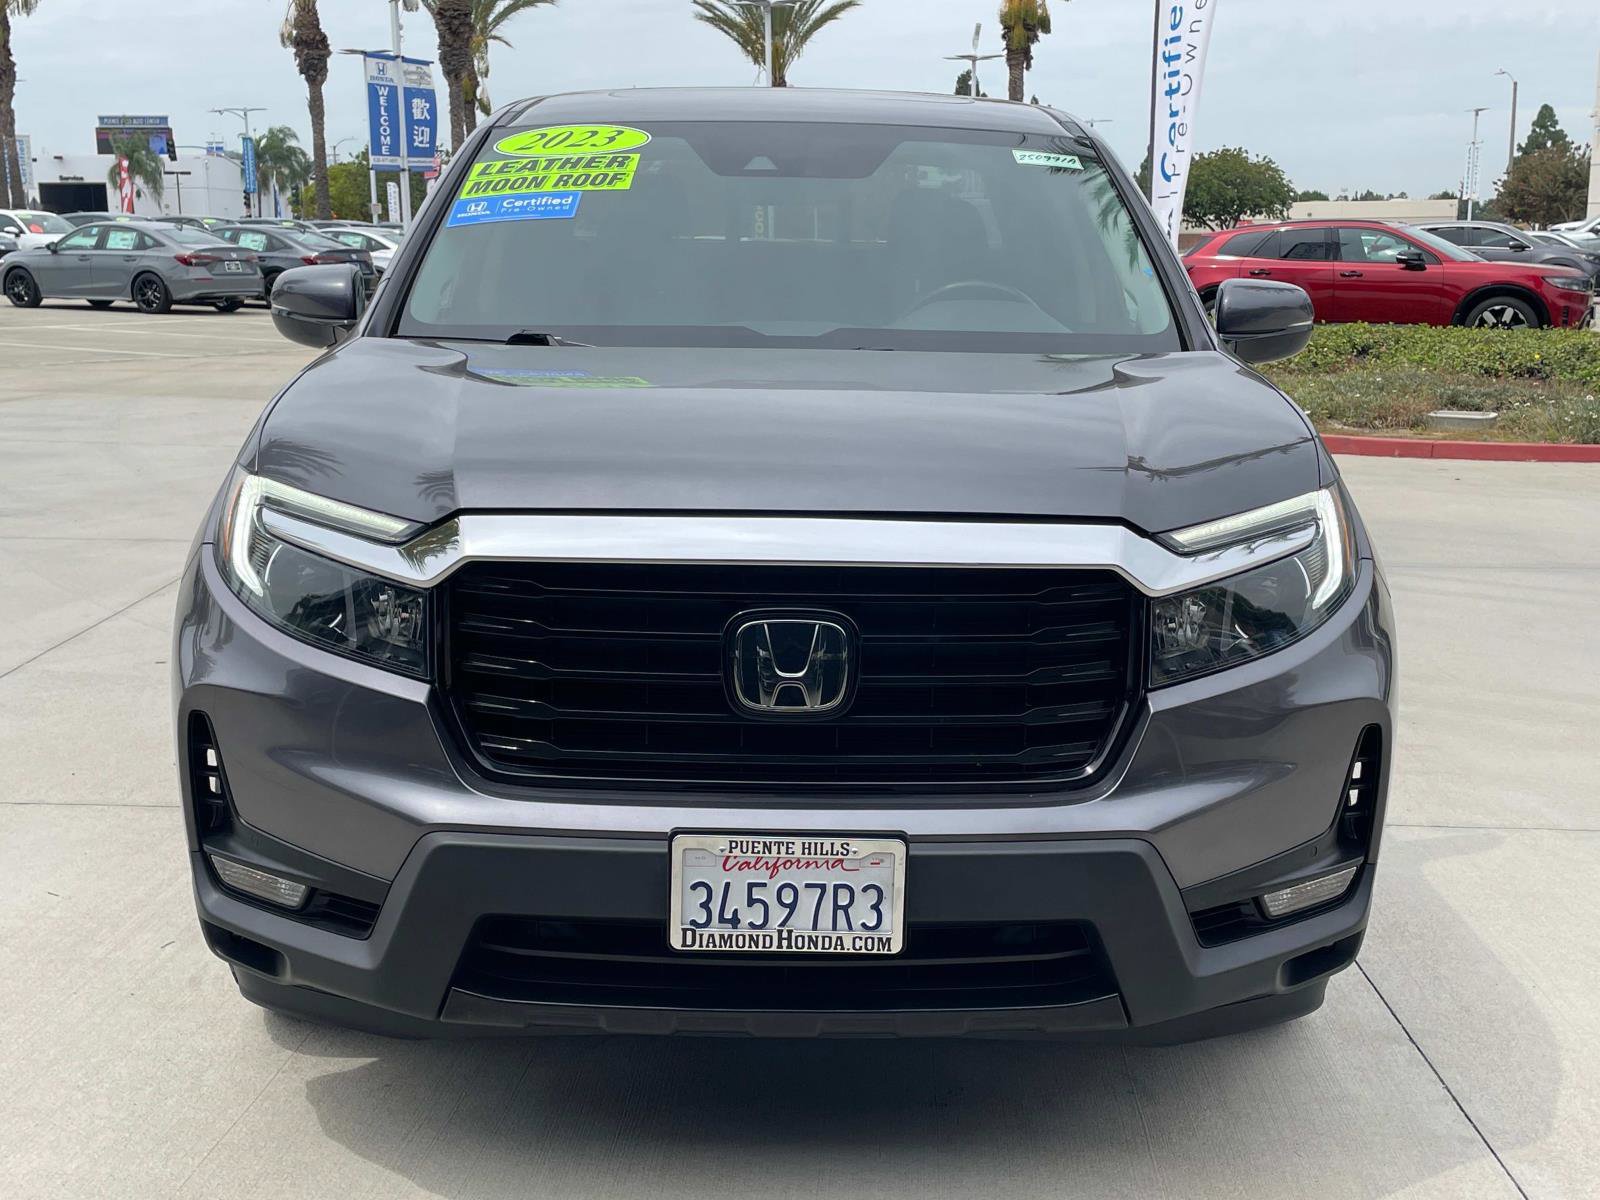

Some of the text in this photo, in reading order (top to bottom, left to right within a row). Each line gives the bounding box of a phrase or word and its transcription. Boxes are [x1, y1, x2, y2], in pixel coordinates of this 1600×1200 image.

[376, 86, 391, 155] WELCOME
[411, 98, 431, 148] 歡迎
[513, 129, 625, 151] 2023
[477, 155, 633, 176] LEATHER
[466, 172, 628, 195] MOON ROOF
[502, 195, 574, 208] Certified
[728, 839, 850, 857] PUENTE HILLS
[721, 856, 860, 880] California
[689, 880, 885, 932] 34597R3
